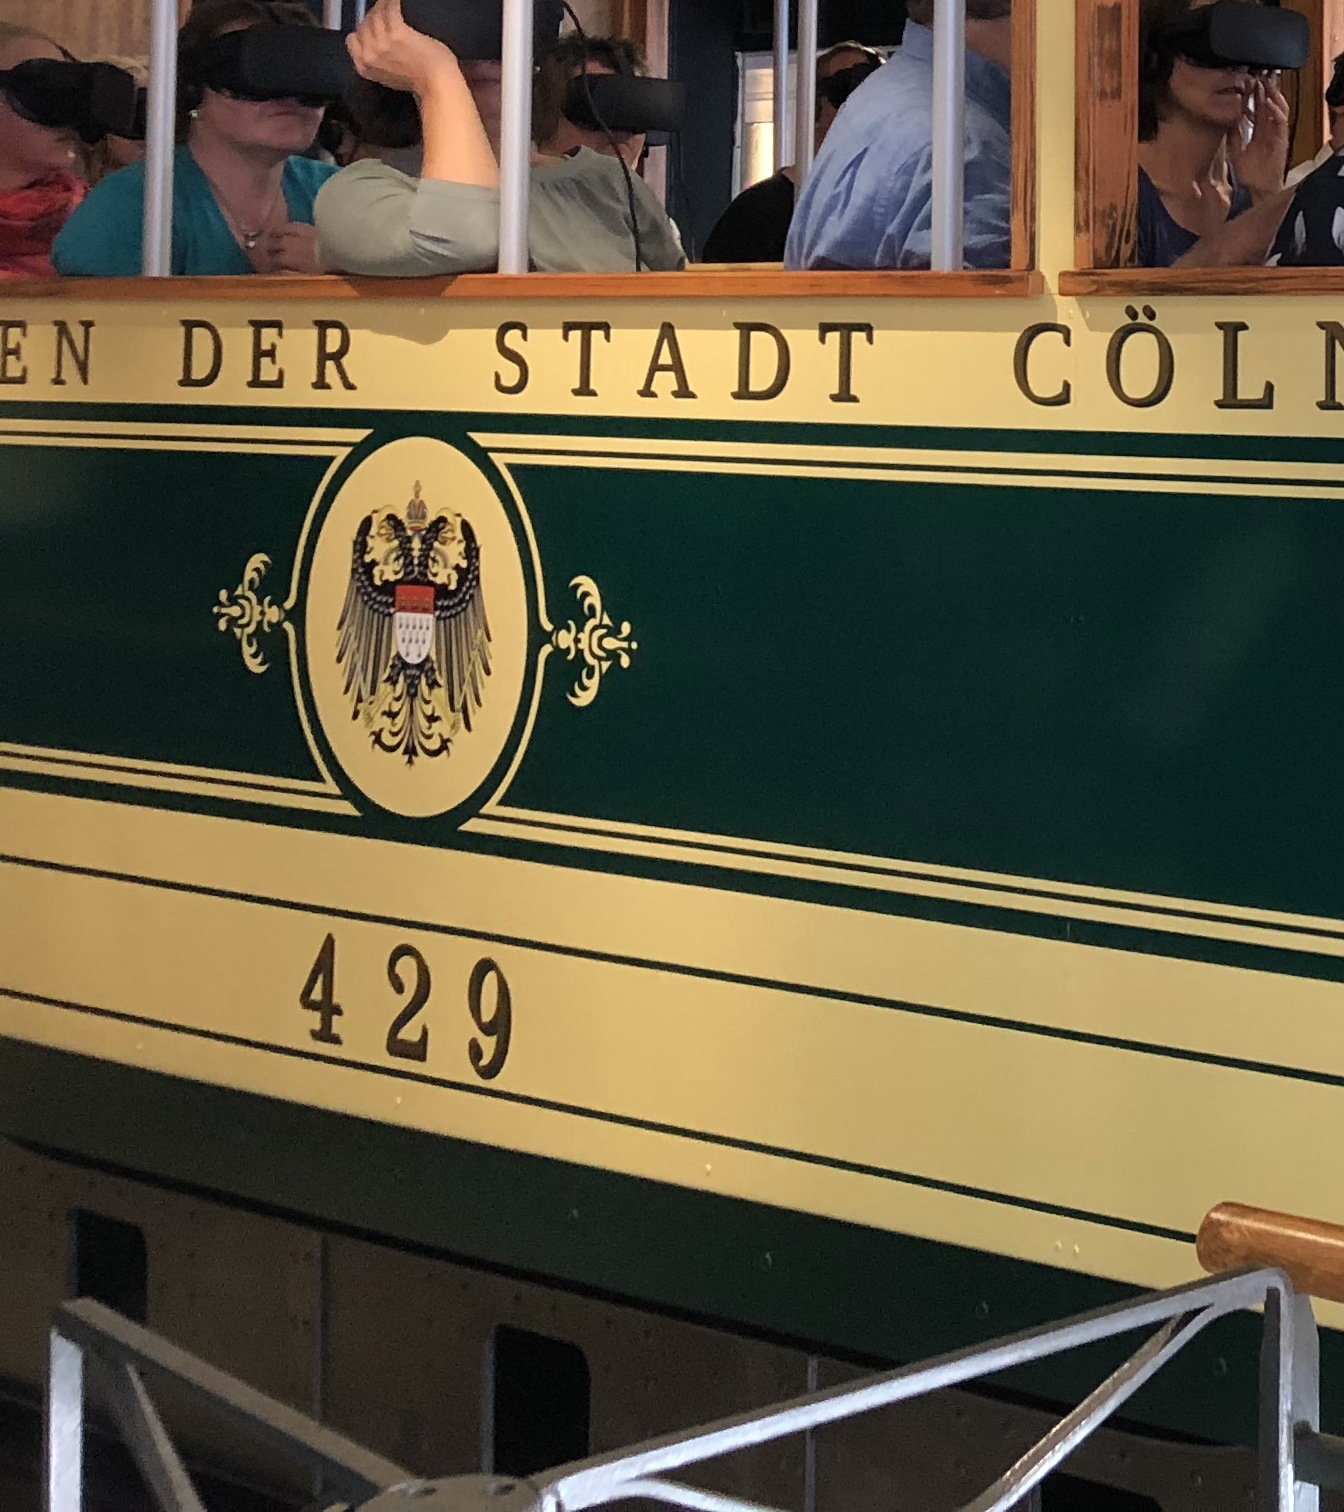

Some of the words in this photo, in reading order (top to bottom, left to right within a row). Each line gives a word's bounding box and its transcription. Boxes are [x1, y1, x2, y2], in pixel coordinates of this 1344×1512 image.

[0, 319, 96, 386] EN
[177, 318, 358, 391] DER
[494, 320, 874, 403] STADT
[300, 932, 512, 1080] 429
